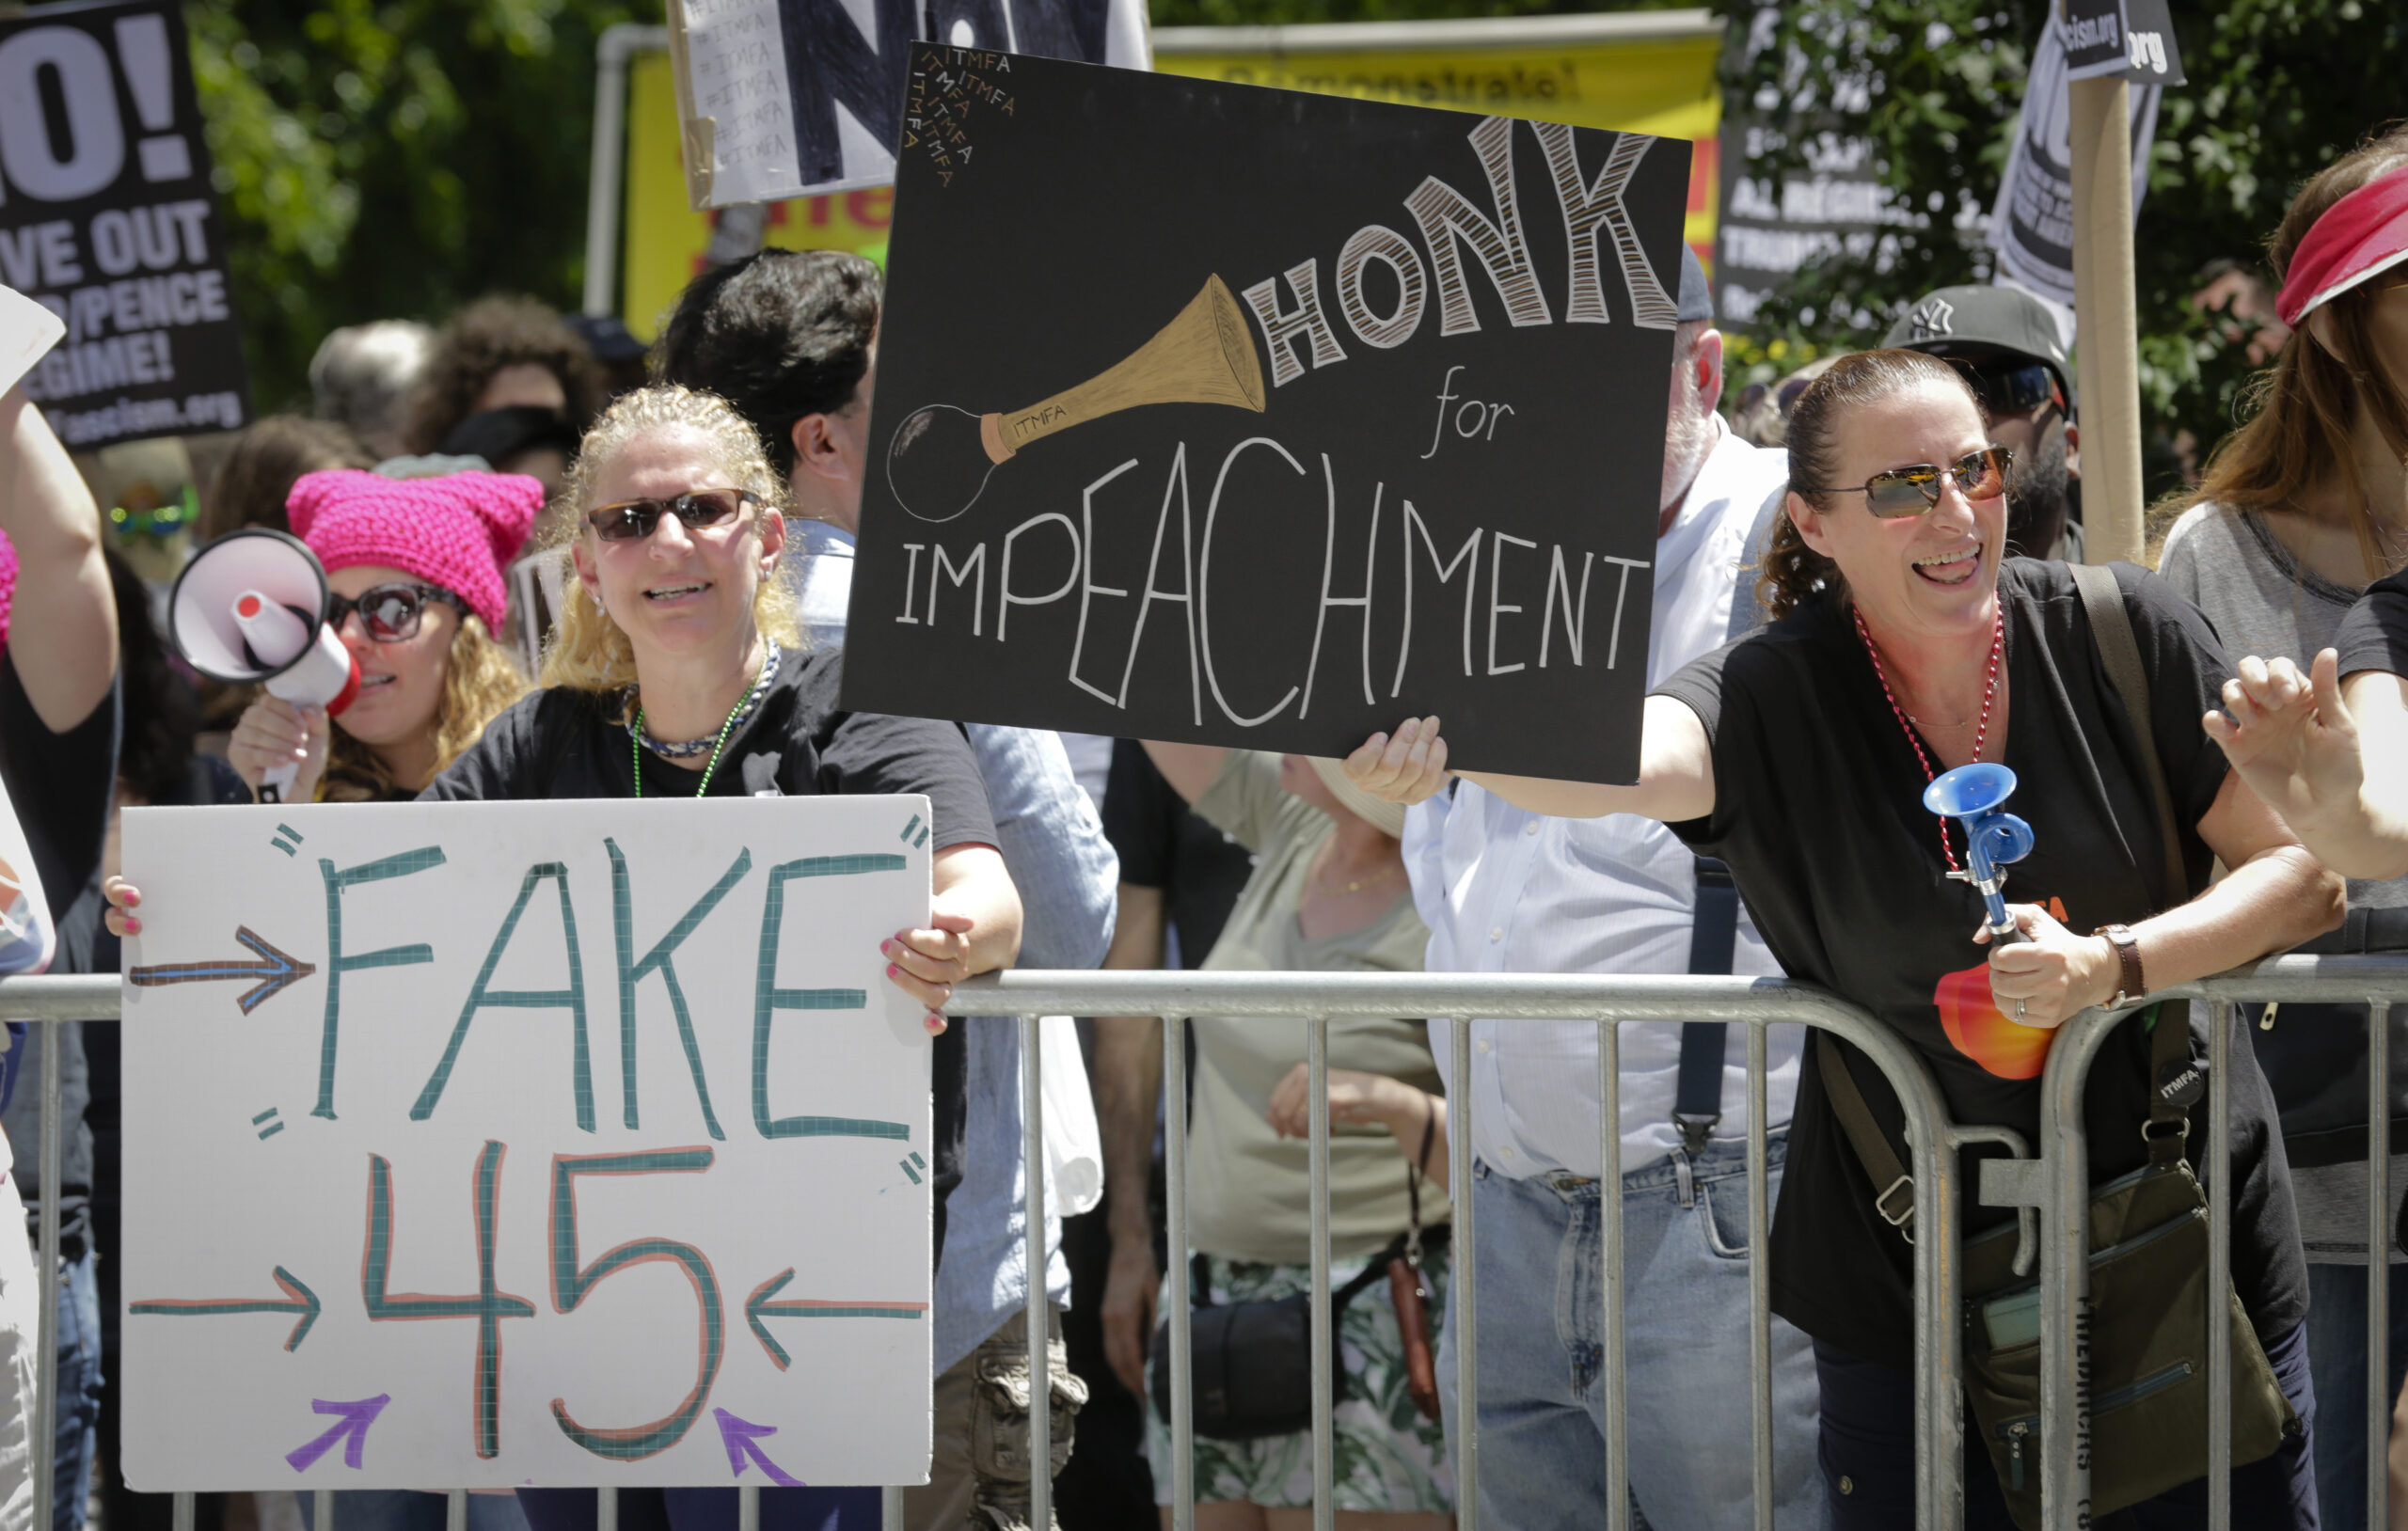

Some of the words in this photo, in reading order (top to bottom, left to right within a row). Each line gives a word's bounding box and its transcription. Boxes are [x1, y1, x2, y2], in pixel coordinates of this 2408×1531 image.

[921, 51, 971, 118] ITMFA
[944, 47, 1010, 72] ITMFA
[958, 71, 1015, 117] ITMFA
[0, 13, 192, 202] O!
[904, 71, 926, 148] ITMFA
[927, 97, 973, 165] ITMFA
[922, 119, 954, 187] ITMFA
[90, 199, 210, 276] OUT
[1242, 116, 1677, 387] HONK
[1013, 403, 1068, 439] ITMFA
[1421, 366, 1515, 459] for
[895, 436, 1651, 727] IMPEACHMENT
[360, 1140, 726, 1462] 45
